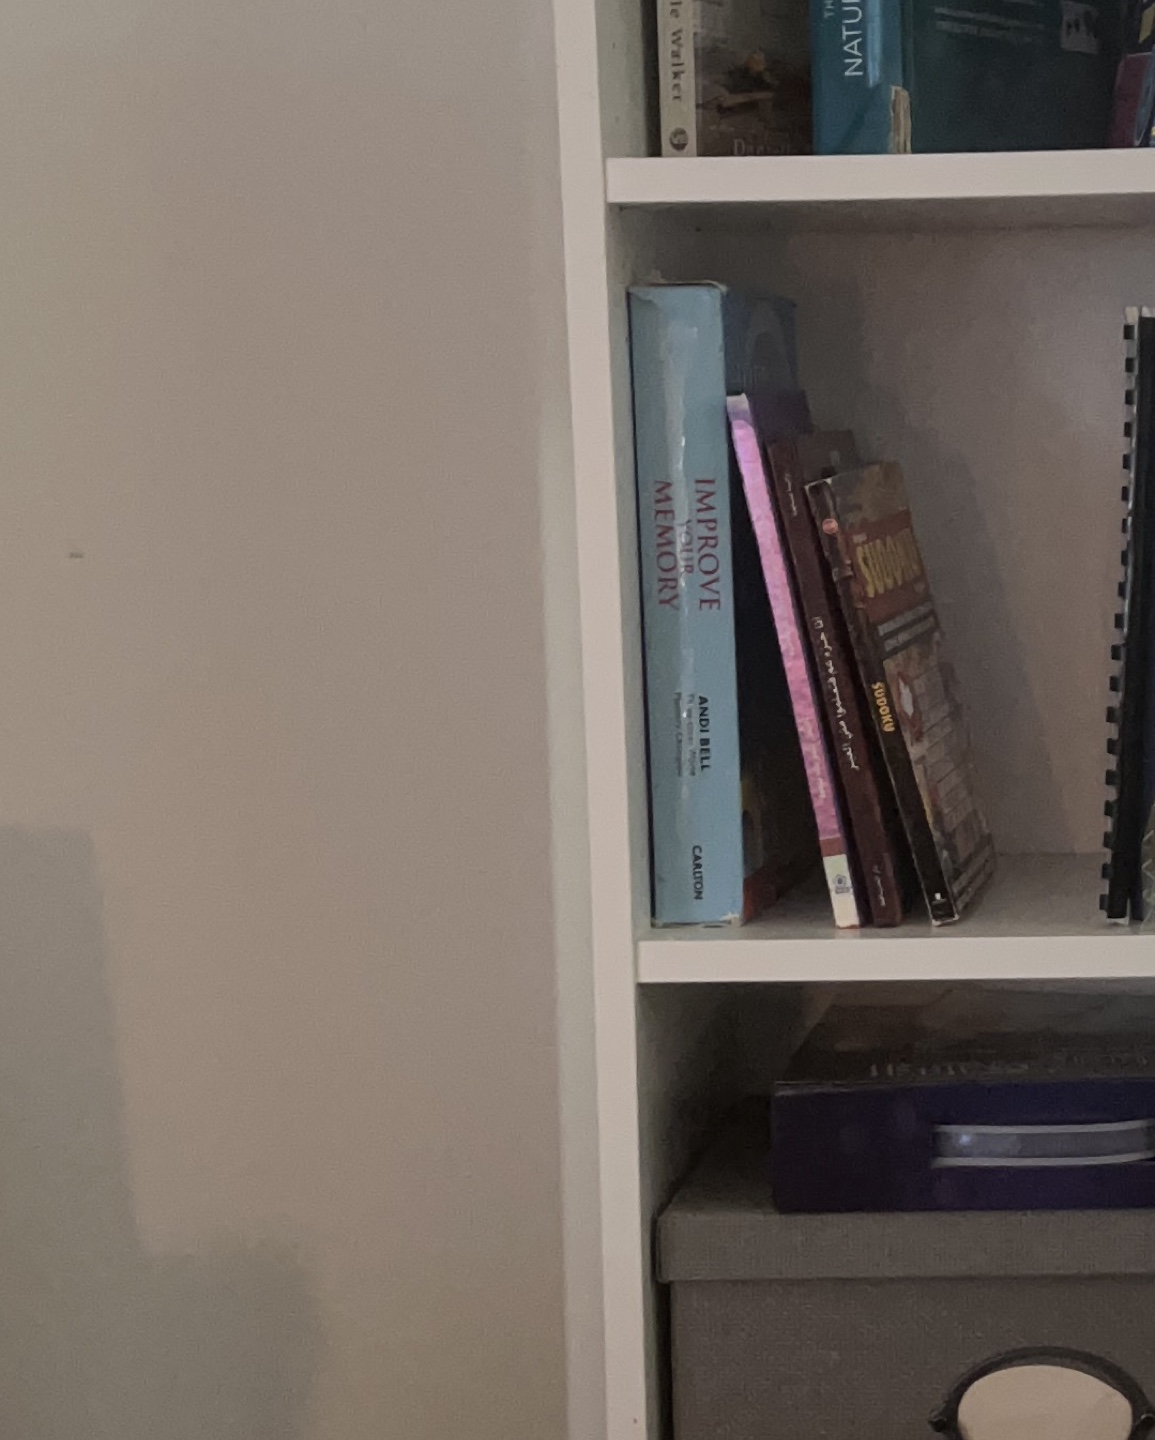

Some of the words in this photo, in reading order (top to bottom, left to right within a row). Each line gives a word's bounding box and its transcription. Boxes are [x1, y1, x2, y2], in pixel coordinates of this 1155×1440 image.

[668, 24, 685, 103] Walker
[653, 479, 680, 612] MEMORY
[678, 518, 695, 576] YOUR
[694, 477, 721, 612] IMPROVE
[698, 695, 710, 733] ANDI
[870, 681, 896, 733] SUDOKU
[699, 737, 712, 772] BELL
[692, 844, 704, 901] CARLTON
